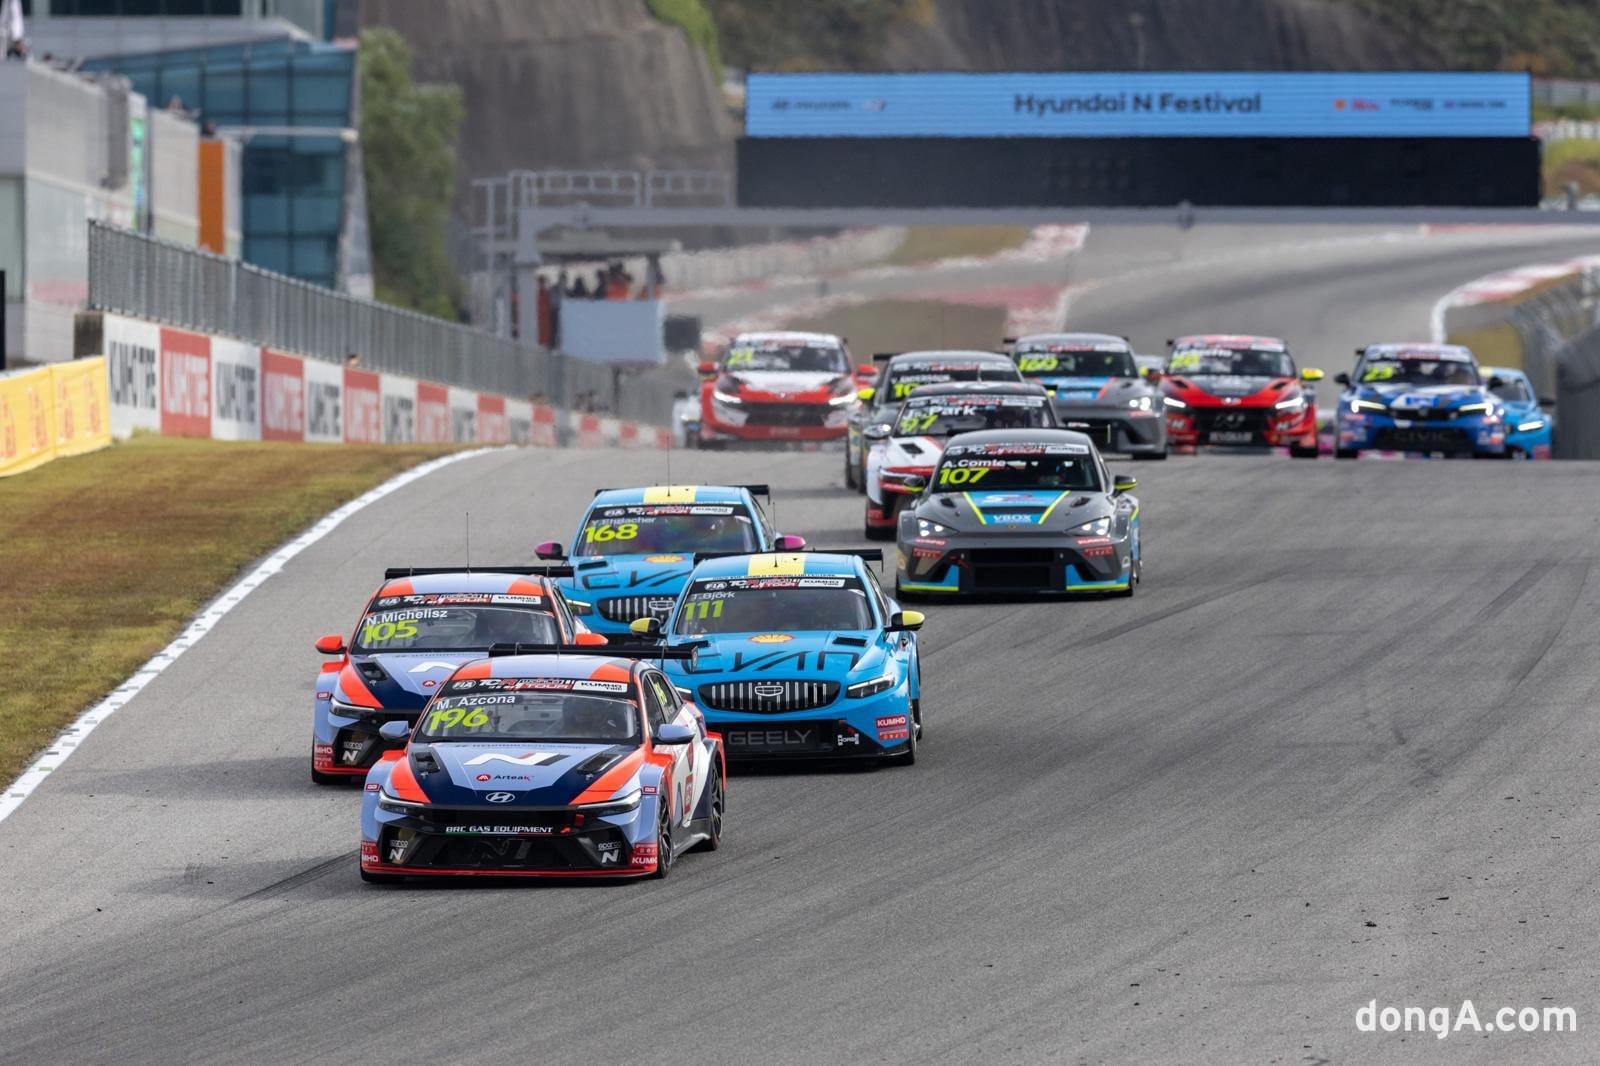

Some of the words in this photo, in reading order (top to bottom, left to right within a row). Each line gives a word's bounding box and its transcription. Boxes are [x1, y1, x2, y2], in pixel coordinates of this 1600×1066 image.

[1014, 92, 1127, 117] Hyundai
[1133, 94, 1151, 112] N
[1160, 92, 1262, 112] Festival
[942, 460, 1006, 469] A.Comte
[939, 467, 990, 484] 107
[993, 514, 1032, 522] VBOX
[584, 524, 639, 544] 168
[367, 609, 448, 625] N.Michelisz
[683, 600, 724, 622] 111
[362, 620, 419, 644] 105
[436, 699, 453, 710] M.
[457, 695, 516, 707] Azcona
[429, 706, 490, 731] 196
[877, 716, 906, 727] KUMHO
[728, 730, 812, 745] GEELY
[493, 826, 553, 834] EQUIPMENT
[601, 850, 619, 863] N
[631, 857, 658, 865] KUMH
